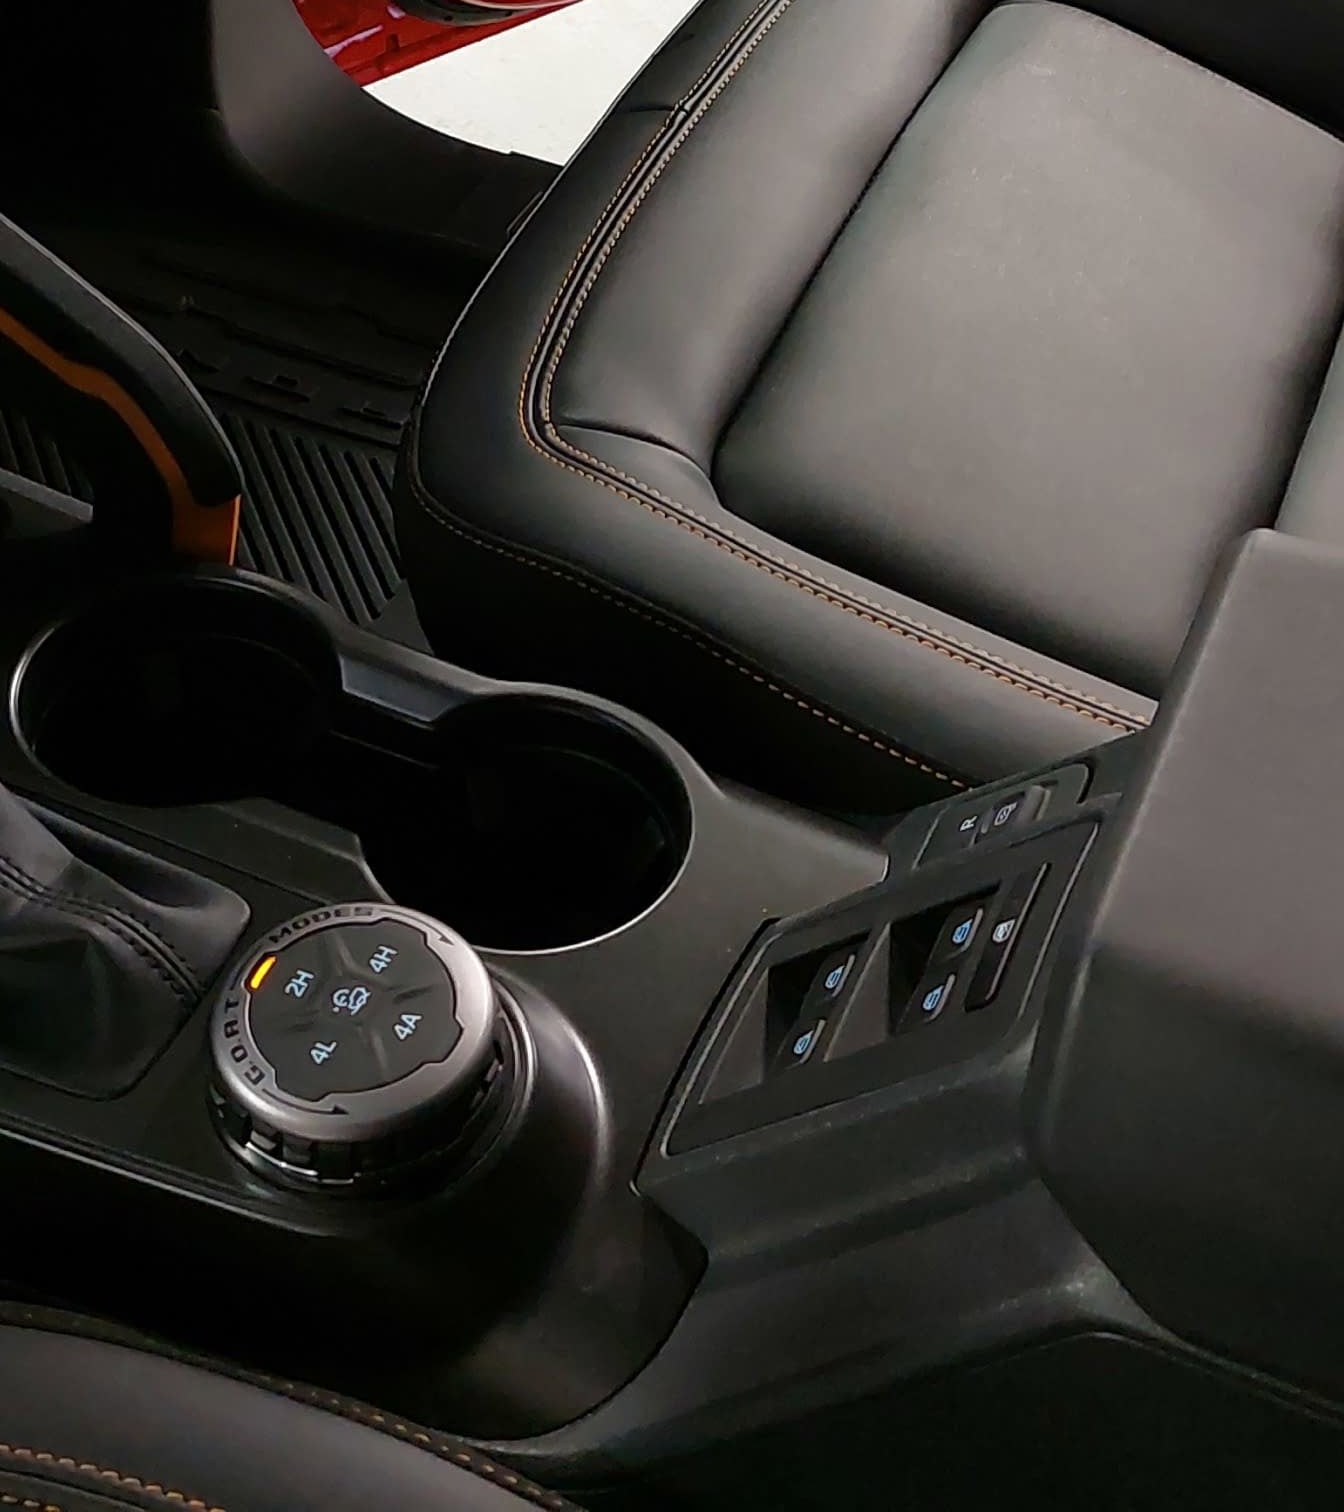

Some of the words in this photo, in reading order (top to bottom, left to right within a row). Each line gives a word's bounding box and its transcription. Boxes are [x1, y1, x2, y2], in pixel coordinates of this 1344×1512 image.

[268, 906, 375, 944] MODES
[369, 945, 398, 974] 4H
[285, 969, 315, 998] 2H
[393, 1013, 423, 1040] 4A
[310, 1039, 338, 1065] 4L
